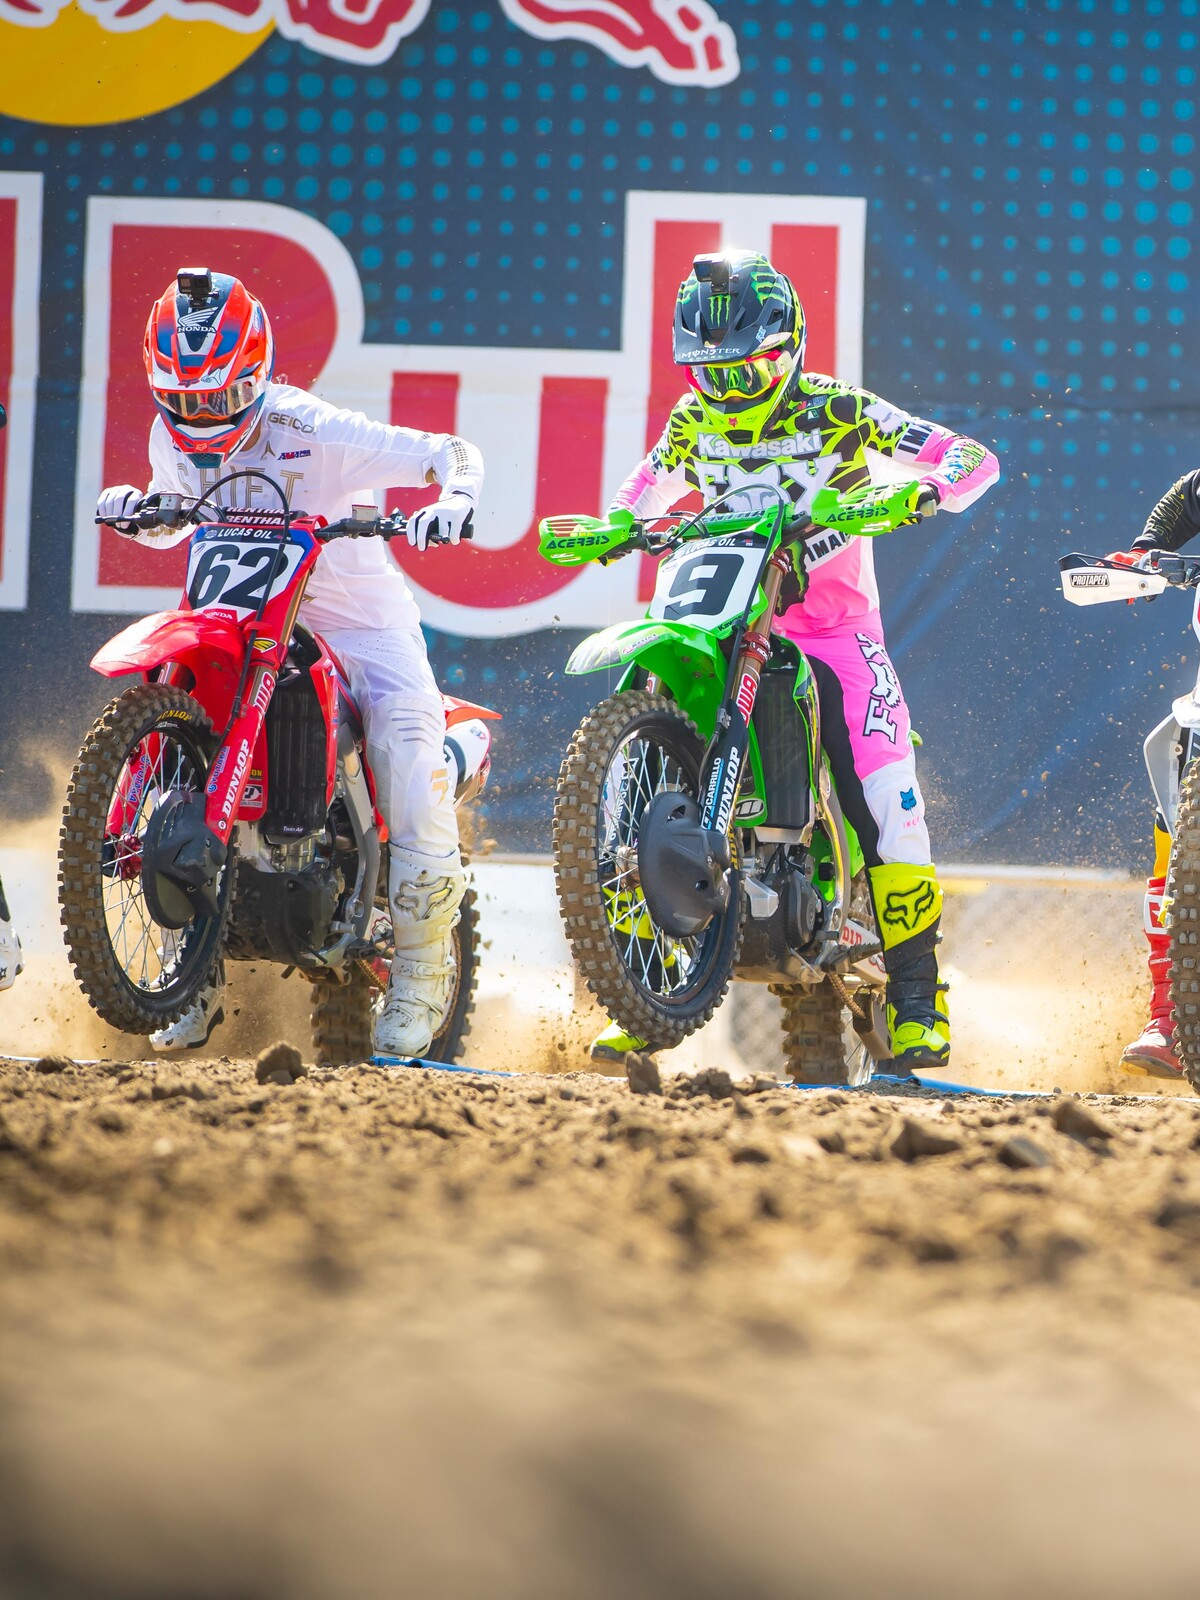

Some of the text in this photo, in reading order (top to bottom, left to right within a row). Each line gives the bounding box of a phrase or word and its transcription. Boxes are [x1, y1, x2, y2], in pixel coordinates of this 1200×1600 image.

[682, 347, 740, 359] MONSTER
[267, 412, 315, 434] GEICO
[697, 428, 823, 459] Kawasaki
[176, 462, 304, 506] SHIFT
[226, 515, 286, 525] RENTHA
[825, 507, 890, 523] ACERBIS
[217, 528, 272, 539] LUCAS OIL
[546, 535, 610, 549] ACERBIS
[686, 538, 736, 554] LUCAS OIL
[187, 544, 289, 611] 62
[664, 554, 745, 620] 9
[1072, 575, 1107, 586] PROTAPER
[222, 738, 249, 818] DUNLOP
[706, 757, 722, 807] CARRILLO
[715, 746, 739, 836] DUNLOP
